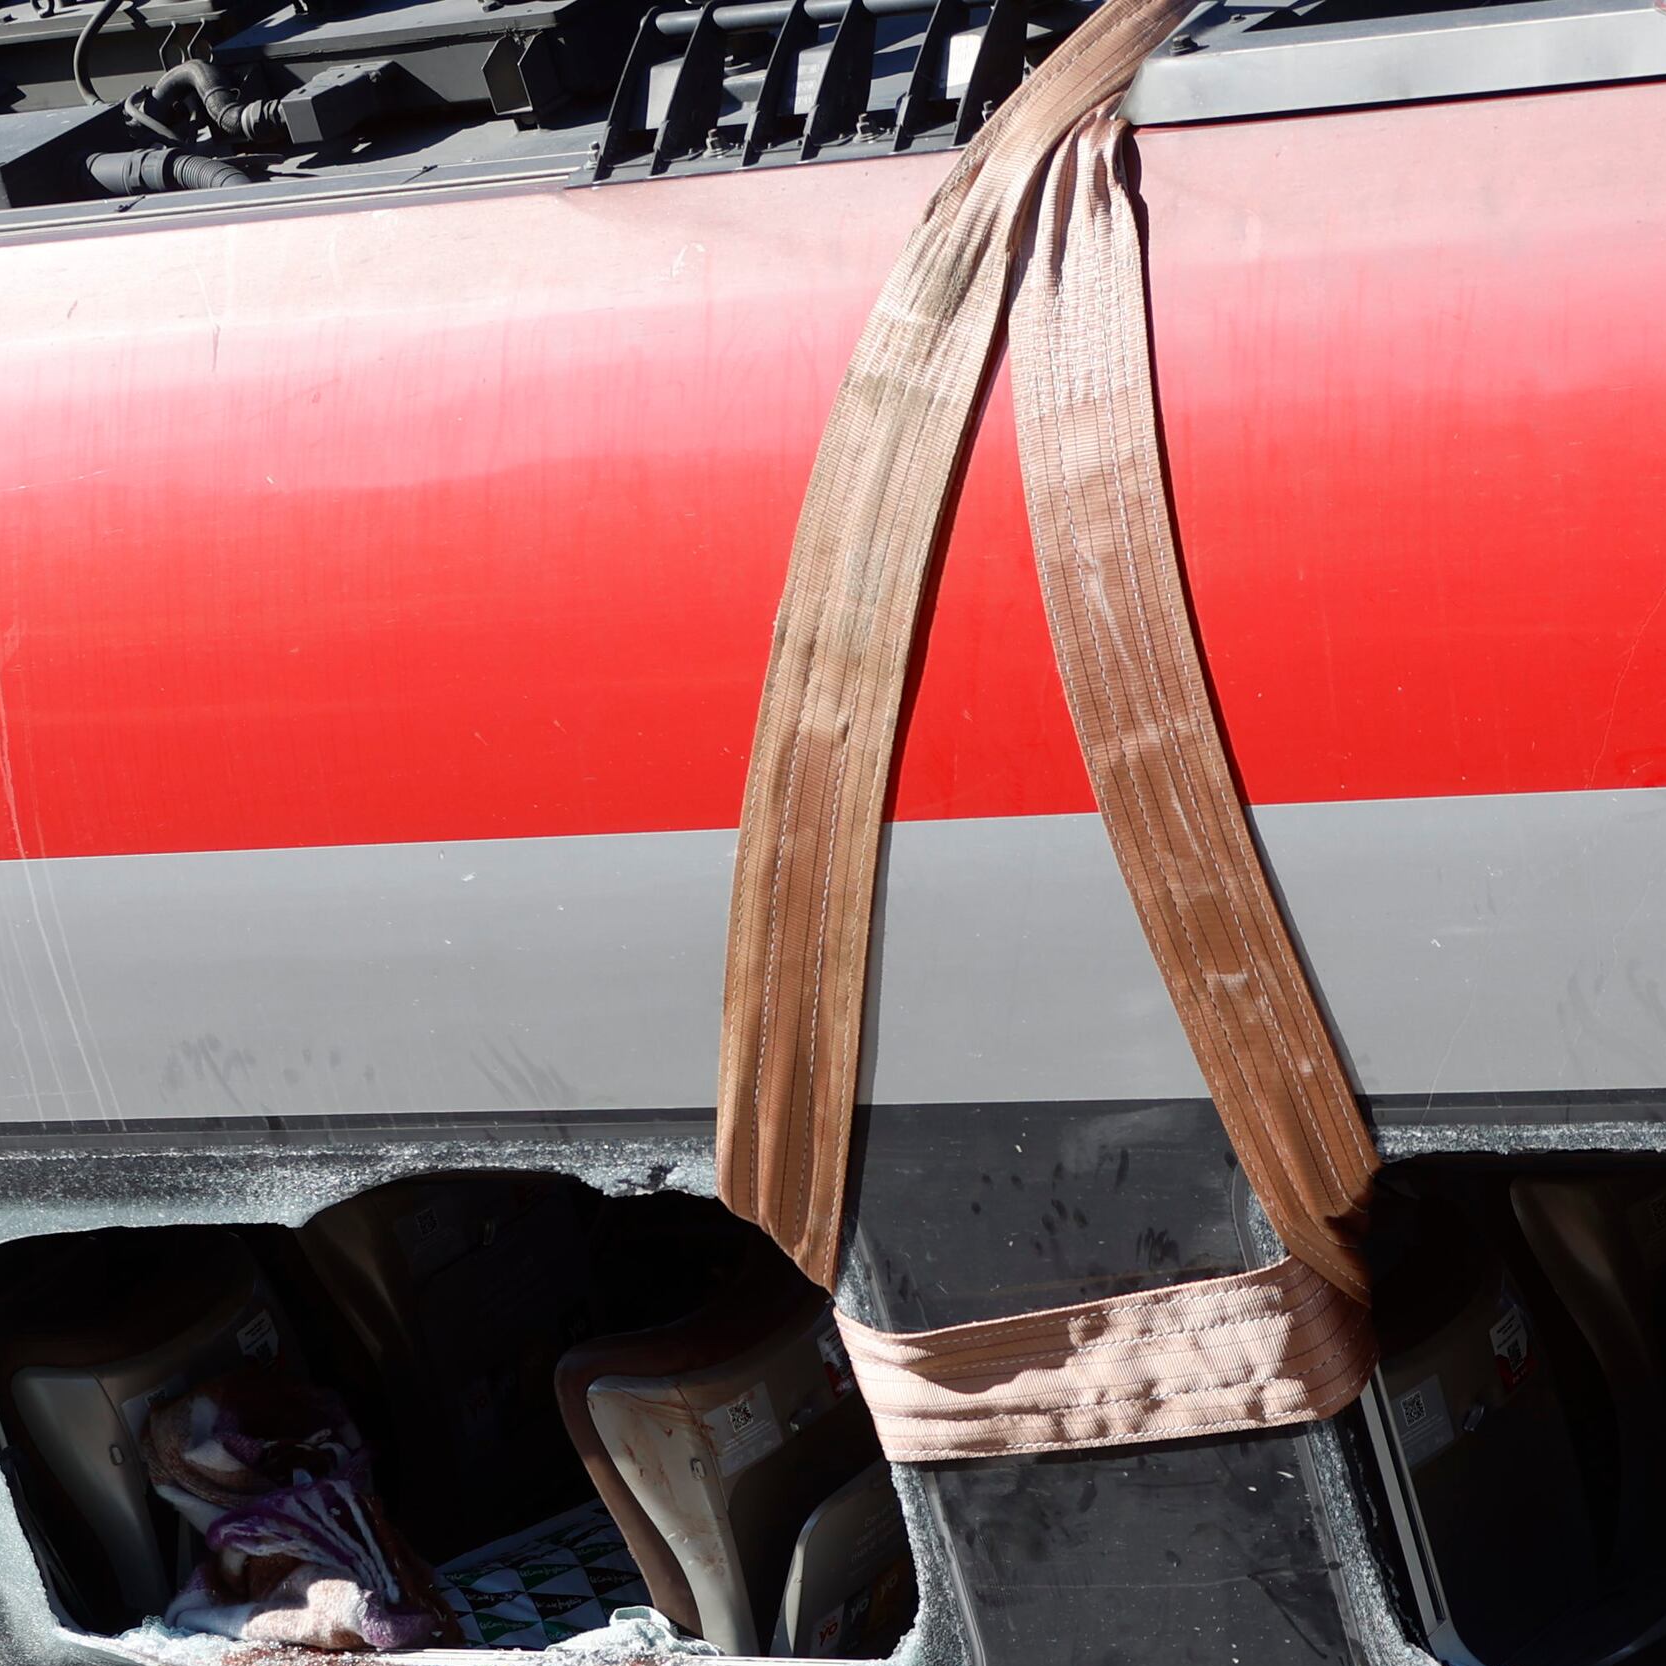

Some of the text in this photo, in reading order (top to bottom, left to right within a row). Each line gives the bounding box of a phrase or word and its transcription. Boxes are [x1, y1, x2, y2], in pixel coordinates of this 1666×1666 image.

[880, 1573, 898, 1600] yo
[850, 1598, 870, 1624] yo
[819, 1622, 838, 1647] yo
